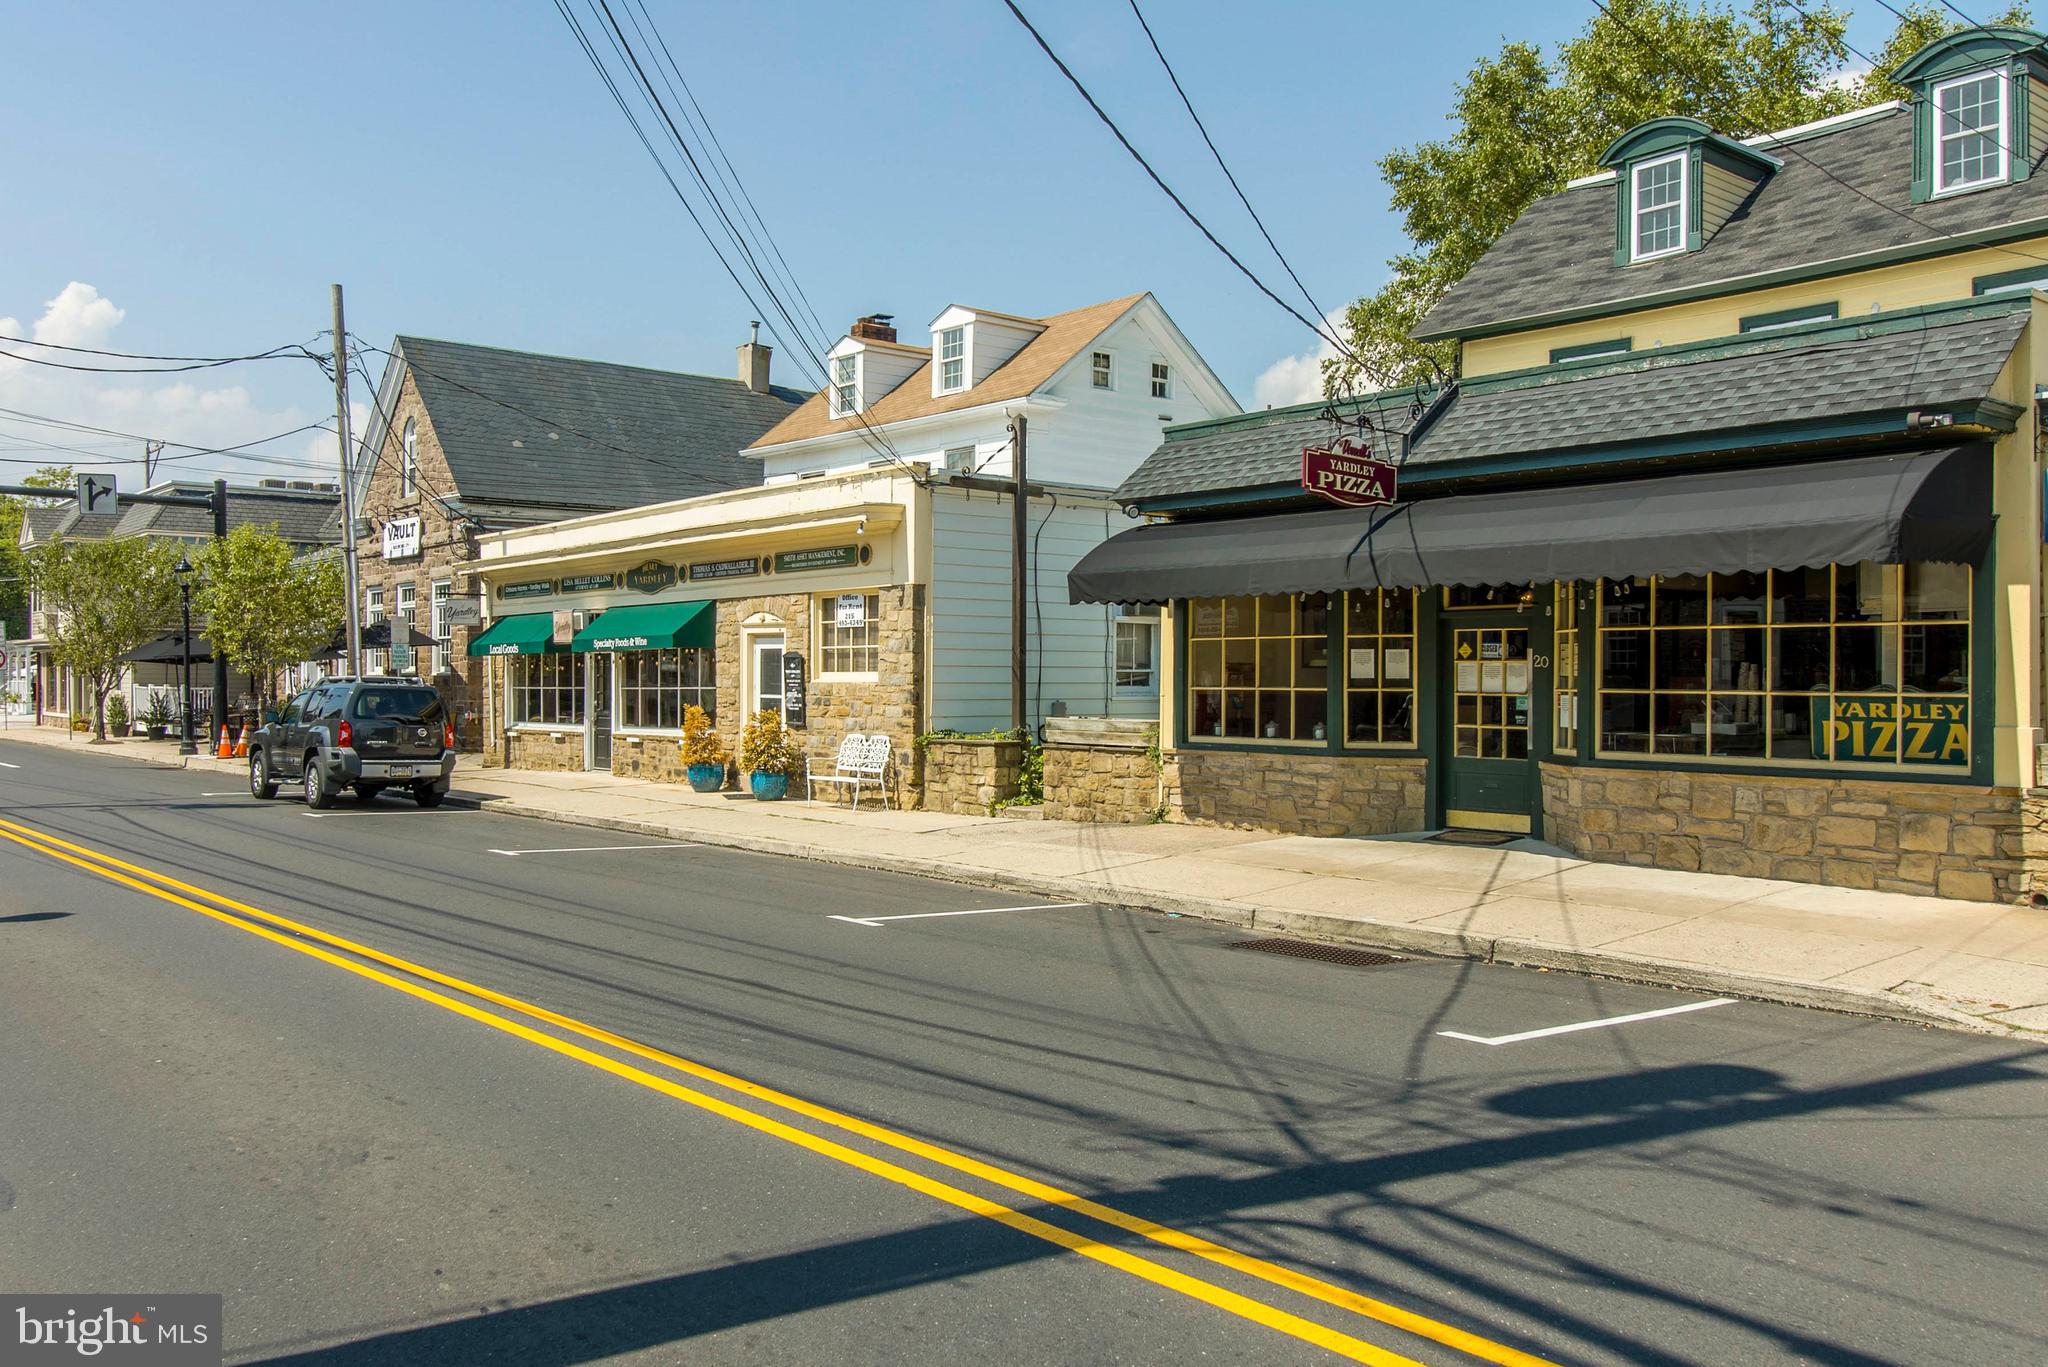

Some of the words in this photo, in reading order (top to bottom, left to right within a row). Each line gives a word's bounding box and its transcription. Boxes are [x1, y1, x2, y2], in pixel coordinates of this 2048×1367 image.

[1330, 459, 1375, 477] YARDLEY
[1317, 470, 1386, 499] PIZZA
[388, 522, 416, 541] VAULT
[564, 578, 574, 586] LISA
[591, 574, 612, 584] COLLINS
[633, 571, 668, 584] YARDLEY
[447, 606, 478, 622] Yardley
[490, 644, 502, 654] Local
[502, 643, 519, 654] Goods
[594, 638, 615, 650] Specialty
[615, 638, 629, 647] Foods
[630, 637, 634, 646] &
[634, 636, 648, 646] Wine
[1533, 654, 1549, 668] 20
[1834, 702, 1965, 720] YARDLEY
[1822, 720, 1968, 760] PIZZA
